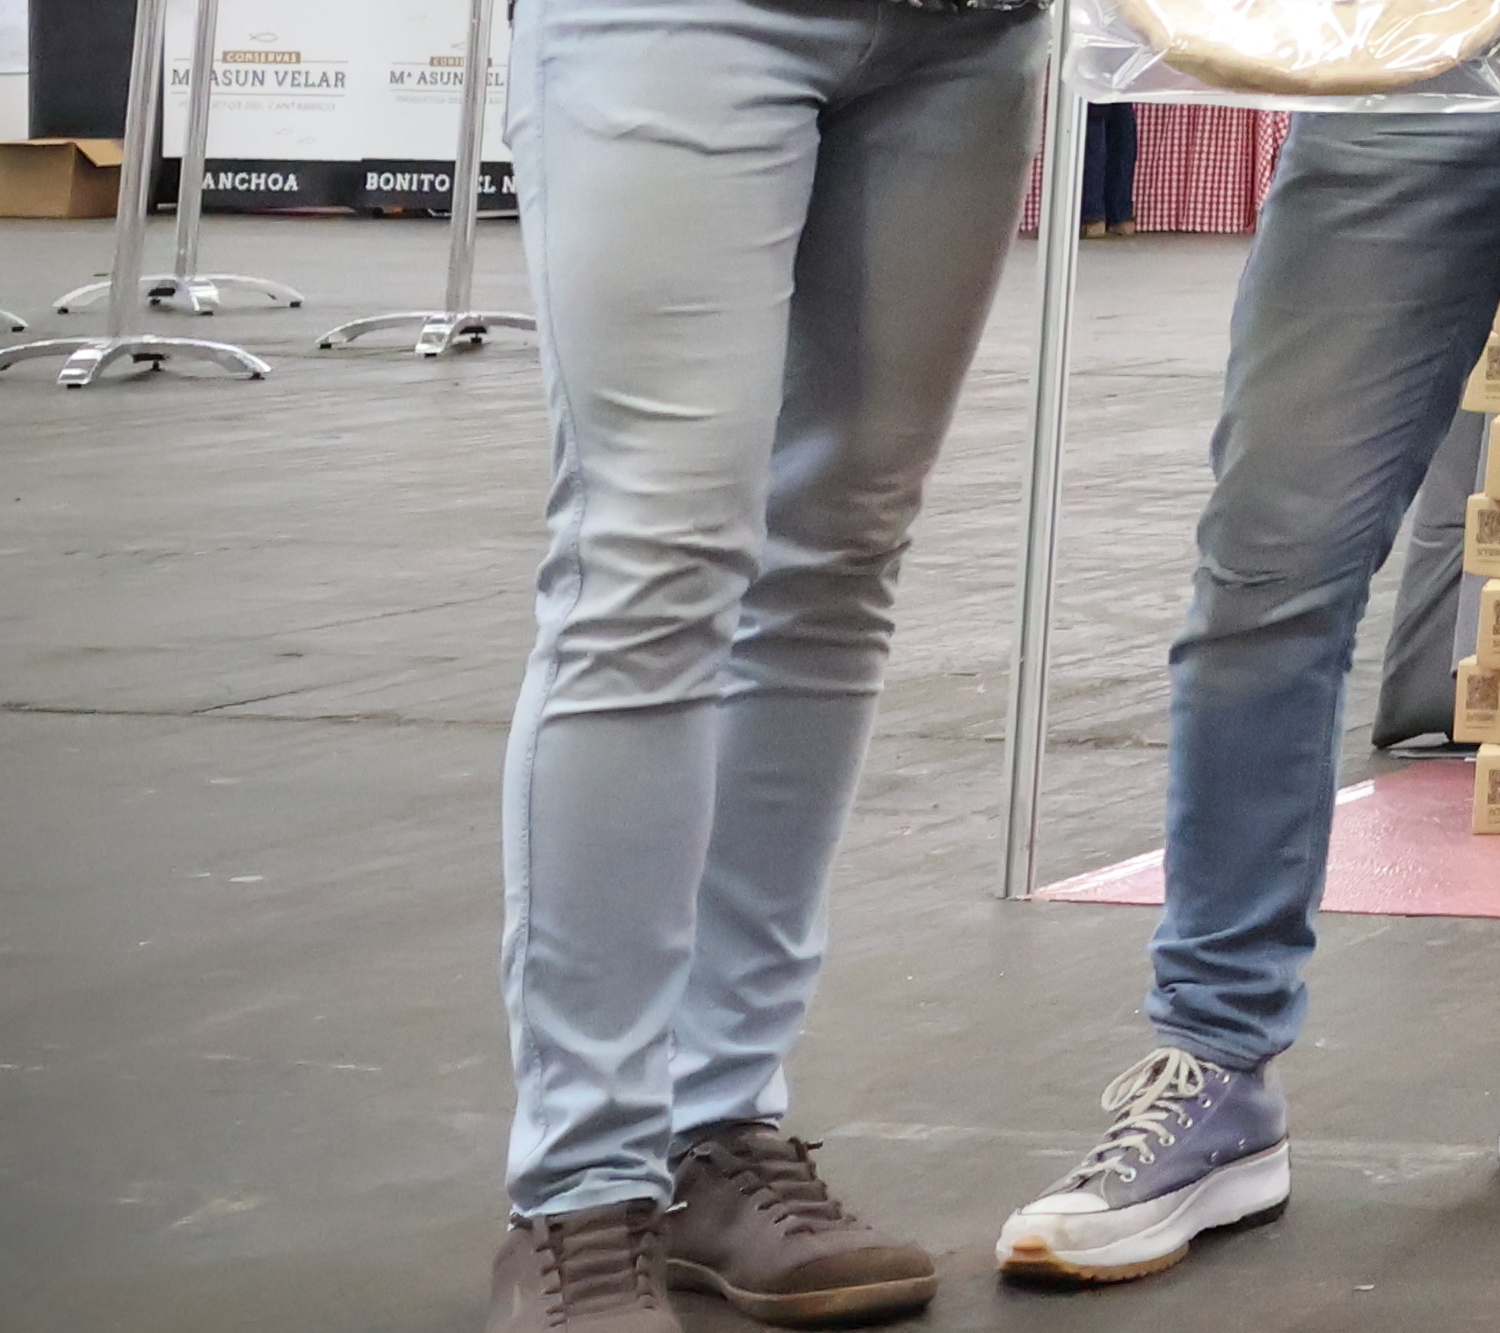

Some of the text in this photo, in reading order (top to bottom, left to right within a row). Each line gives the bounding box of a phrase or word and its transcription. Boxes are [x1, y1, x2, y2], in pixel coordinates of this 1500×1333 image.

[273, 70, 346, 89] VELAR
[203, 173, 299, 192] ANCHOA
[366, 173, 451, 192] BONITO
